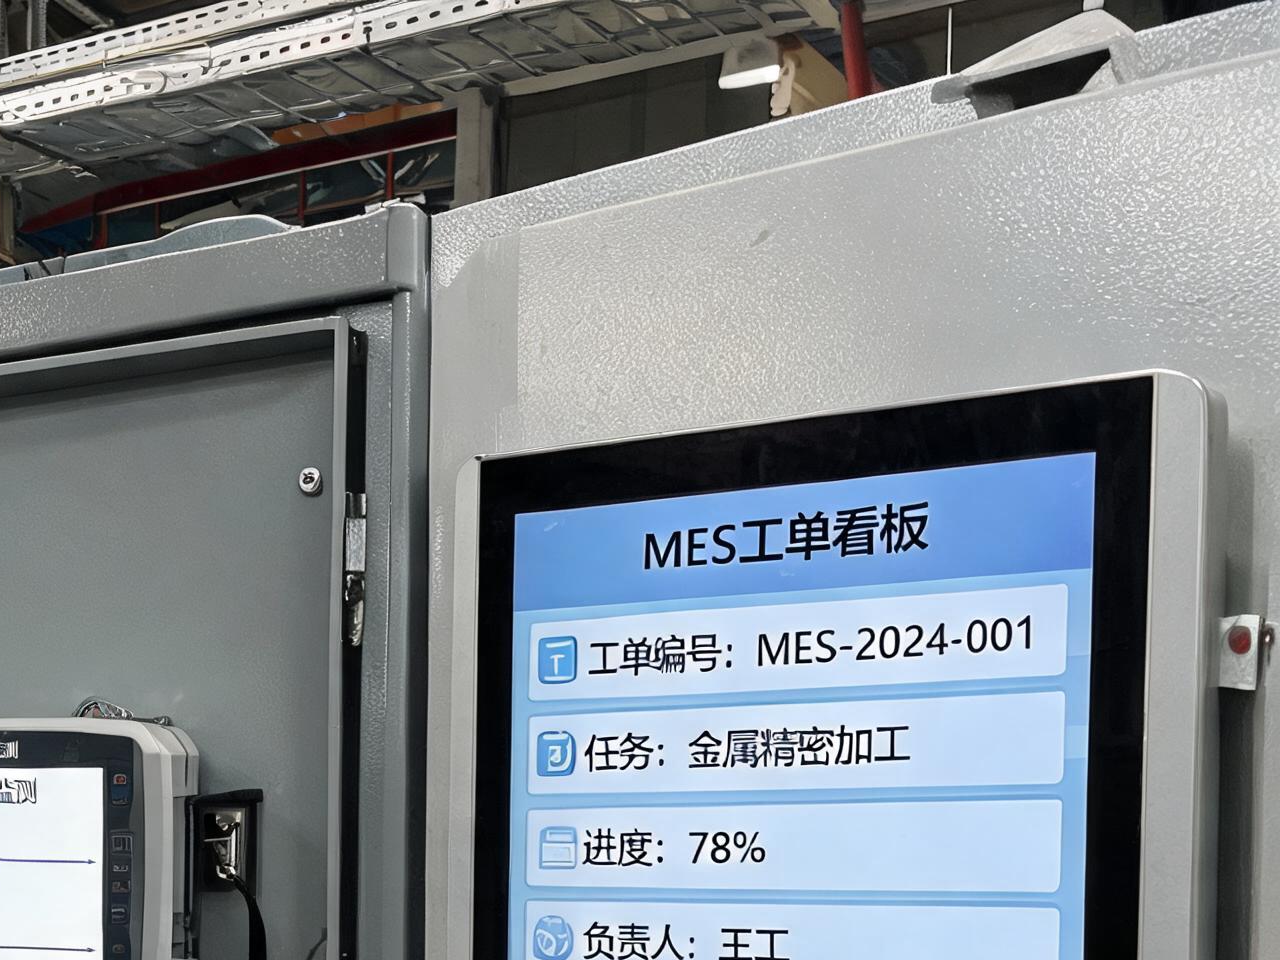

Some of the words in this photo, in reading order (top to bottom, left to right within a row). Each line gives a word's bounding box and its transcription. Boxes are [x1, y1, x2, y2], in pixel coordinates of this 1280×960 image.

[643, 501, 930, 571] MES工单看板
[756, 613, 1032, 668] MES-2024-001
[687, 725, 912, 769] 金属精密加工
[687, 830, 767, 864] 78%
